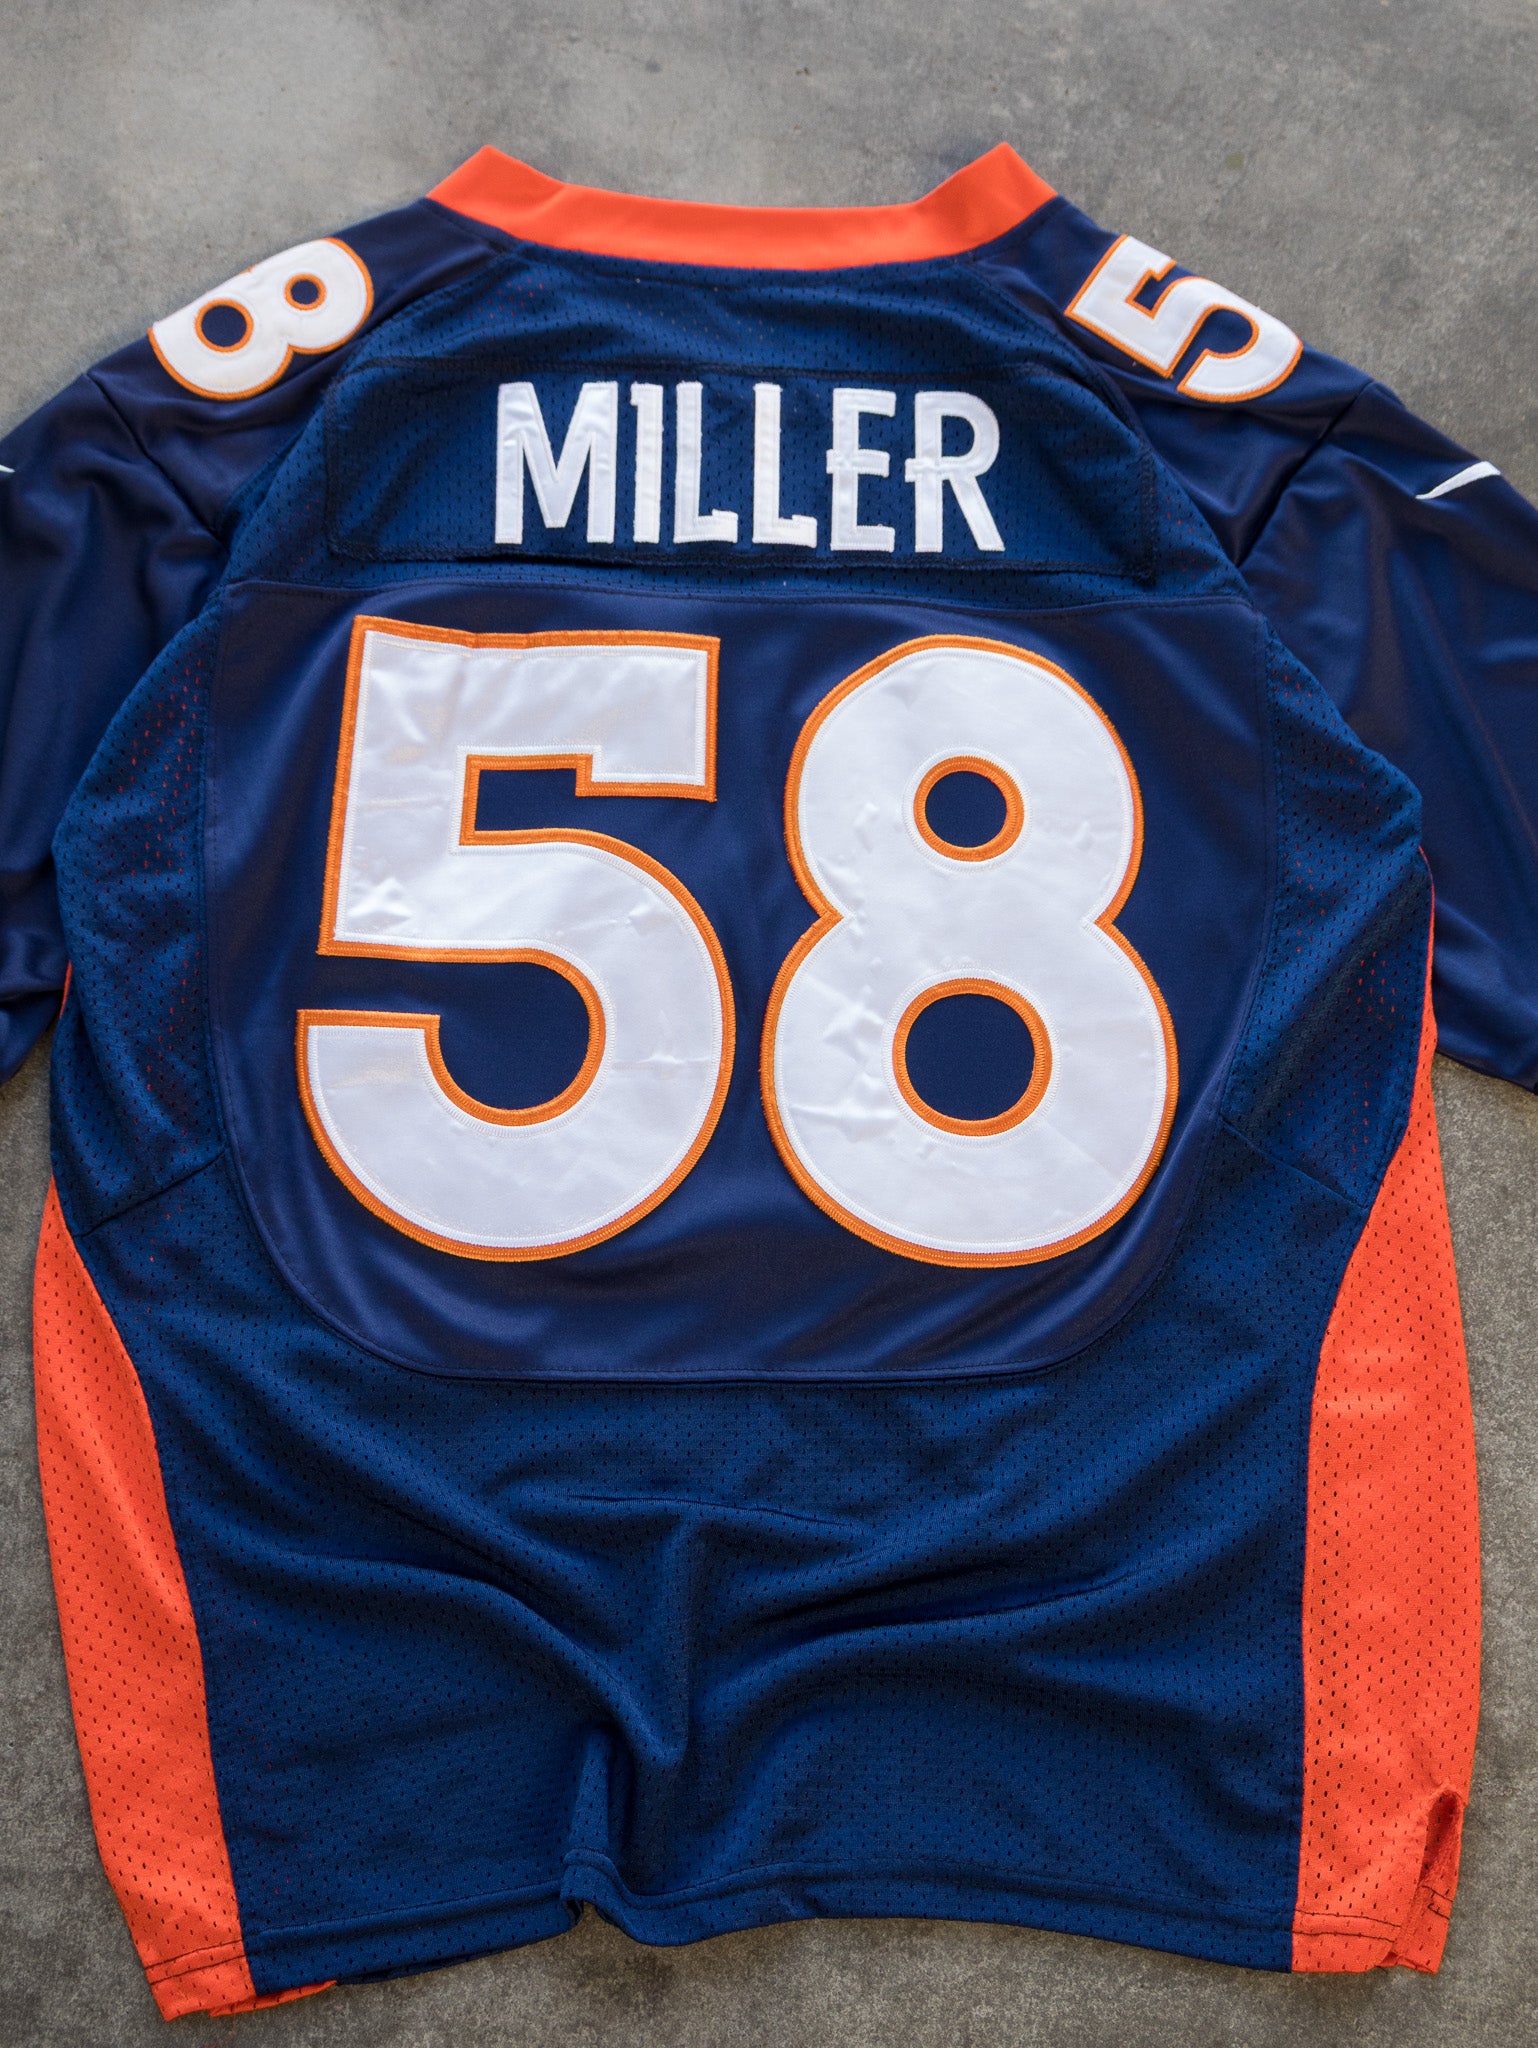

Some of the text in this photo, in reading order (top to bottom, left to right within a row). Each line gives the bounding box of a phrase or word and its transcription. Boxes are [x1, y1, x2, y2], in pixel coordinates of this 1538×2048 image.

[148, 237, 374, 400] 8
[1064, 233, 1303, 403] 5
[494, 380, 1005, 553] MILLER
[297, 615, 1179, 1268] 58
